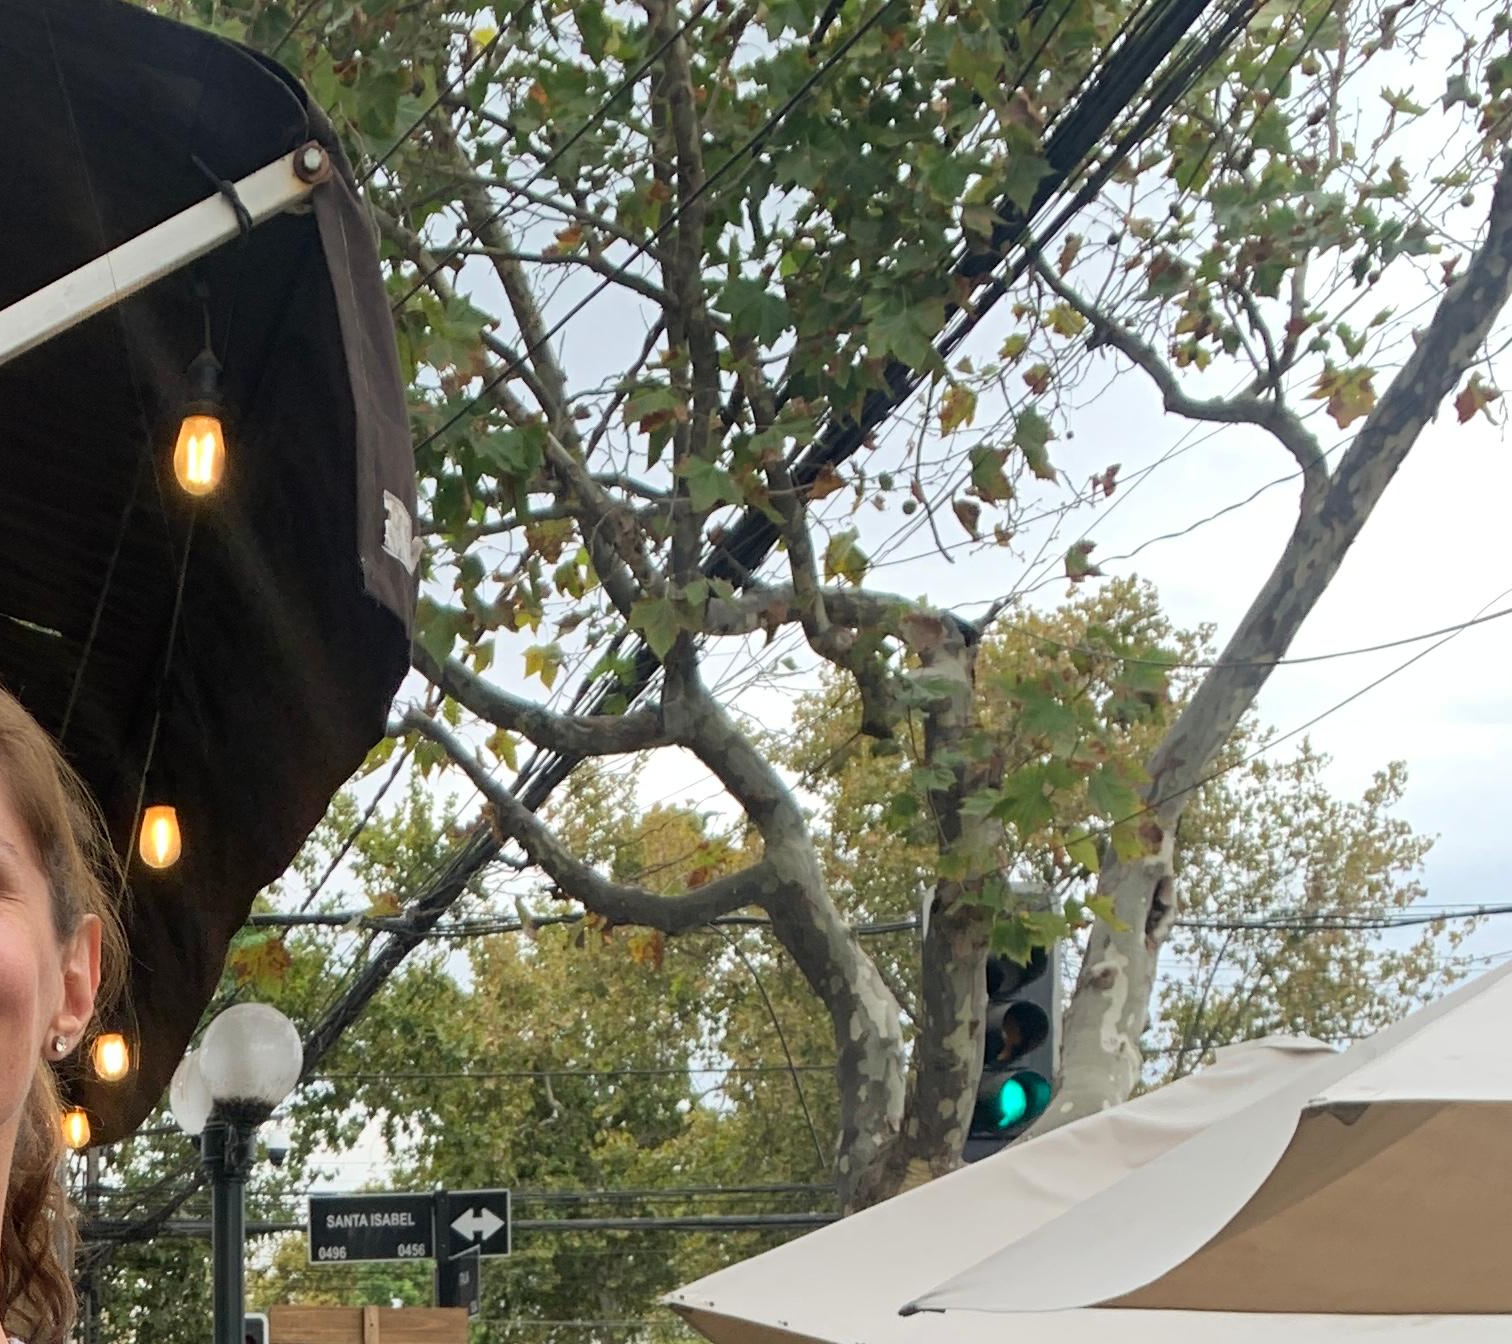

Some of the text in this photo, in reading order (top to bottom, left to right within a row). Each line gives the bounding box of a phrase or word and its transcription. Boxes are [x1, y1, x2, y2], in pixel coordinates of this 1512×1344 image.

[326, 1212, 416, 1229] SANTA ISABEL
[318, 1246, 347, 1260] 0496
[397, 1243, 426, 1257] 0456
